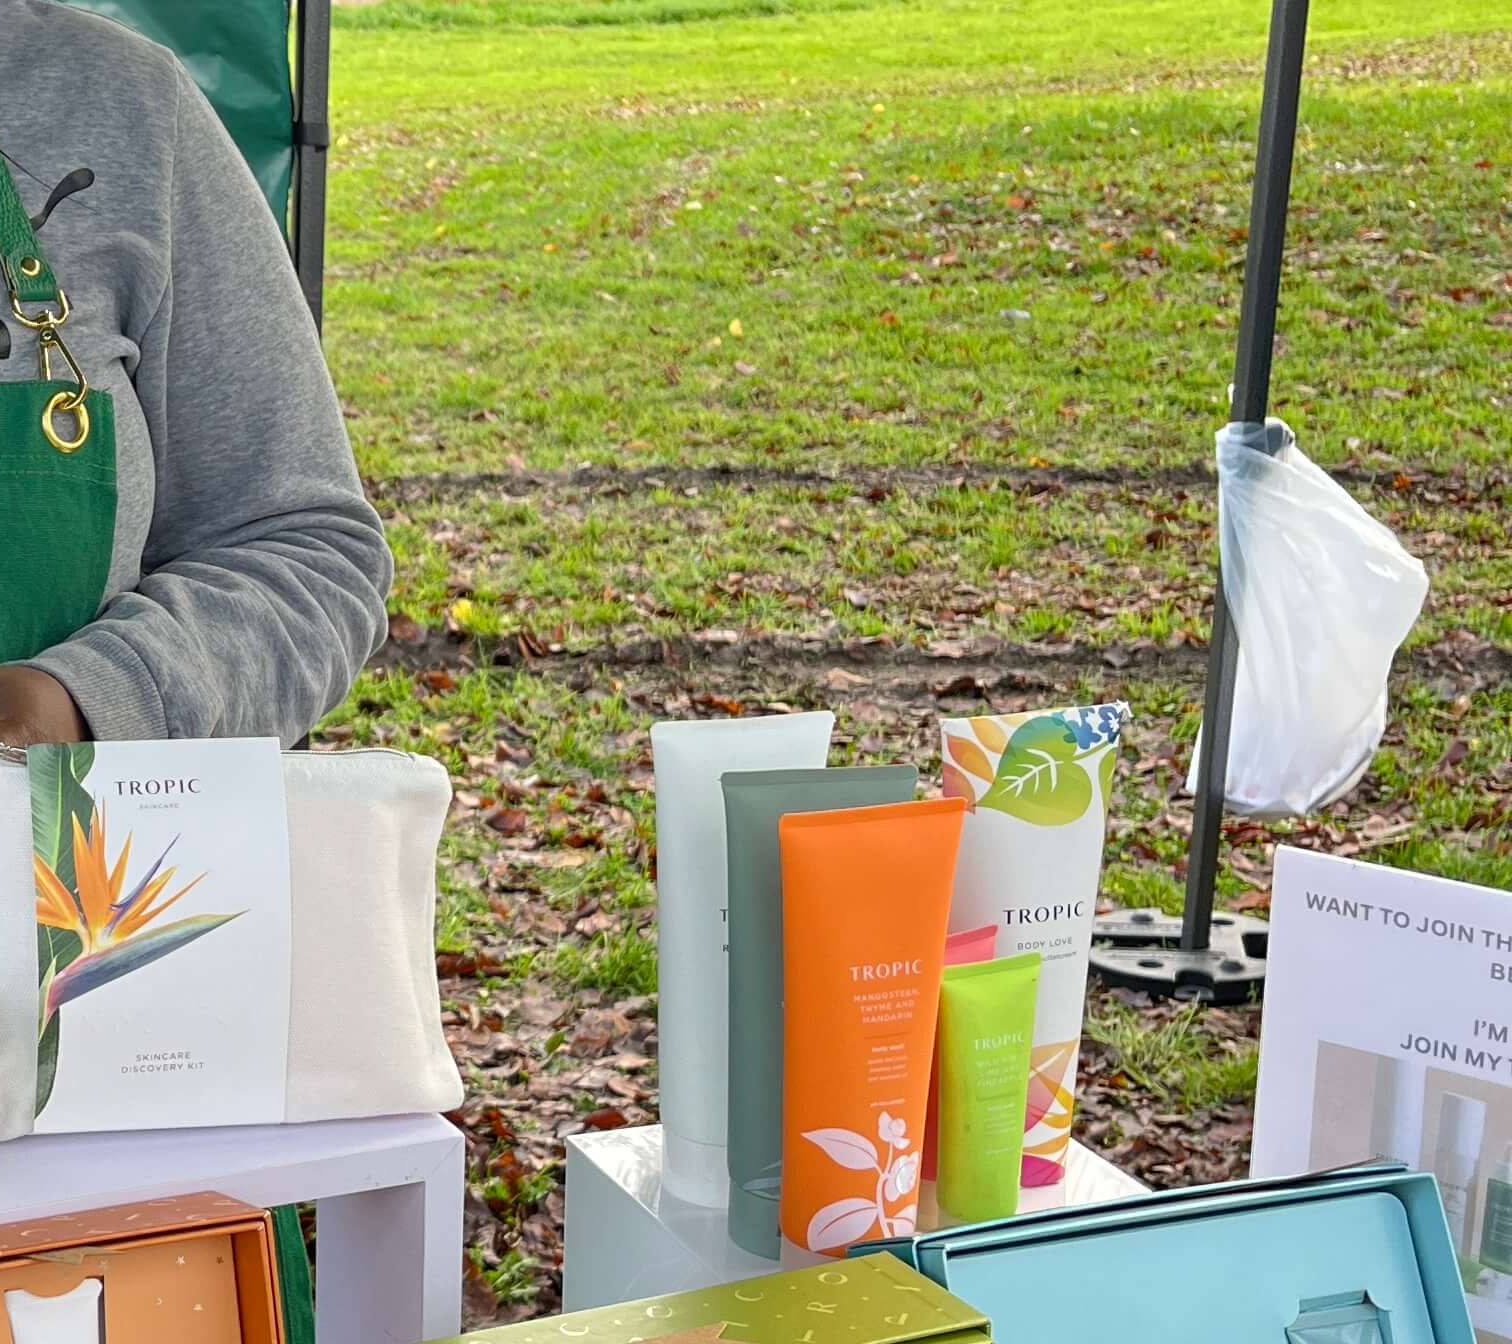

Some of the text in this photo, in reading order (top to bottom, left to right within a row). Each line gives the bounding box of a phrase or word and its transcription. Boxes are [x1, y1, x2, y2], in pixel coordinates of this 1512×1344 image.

[114, 778, 201, 795] TROPIC
[1002, 900, 1085, 925] TROPIC
[1306, 892, 1374, 921] WANT
[1380, 908, 1411, 929] TO
[1416, 918, 1474, 943] JOIN
[1017, 936, 1073, 950] BODY LOVE
[849, 958, 923, 982] TROPIC
[974, 1032, 1025, 1050] TROPIC
[1473, 1019, 1508, 1043] I'M
[135, 1051, 192, 1062] SKINCARE
[1400, 1033, 1503, 1072] JOIN MY
[121, 1061, 205, 1074] DISCOVERY KIT
